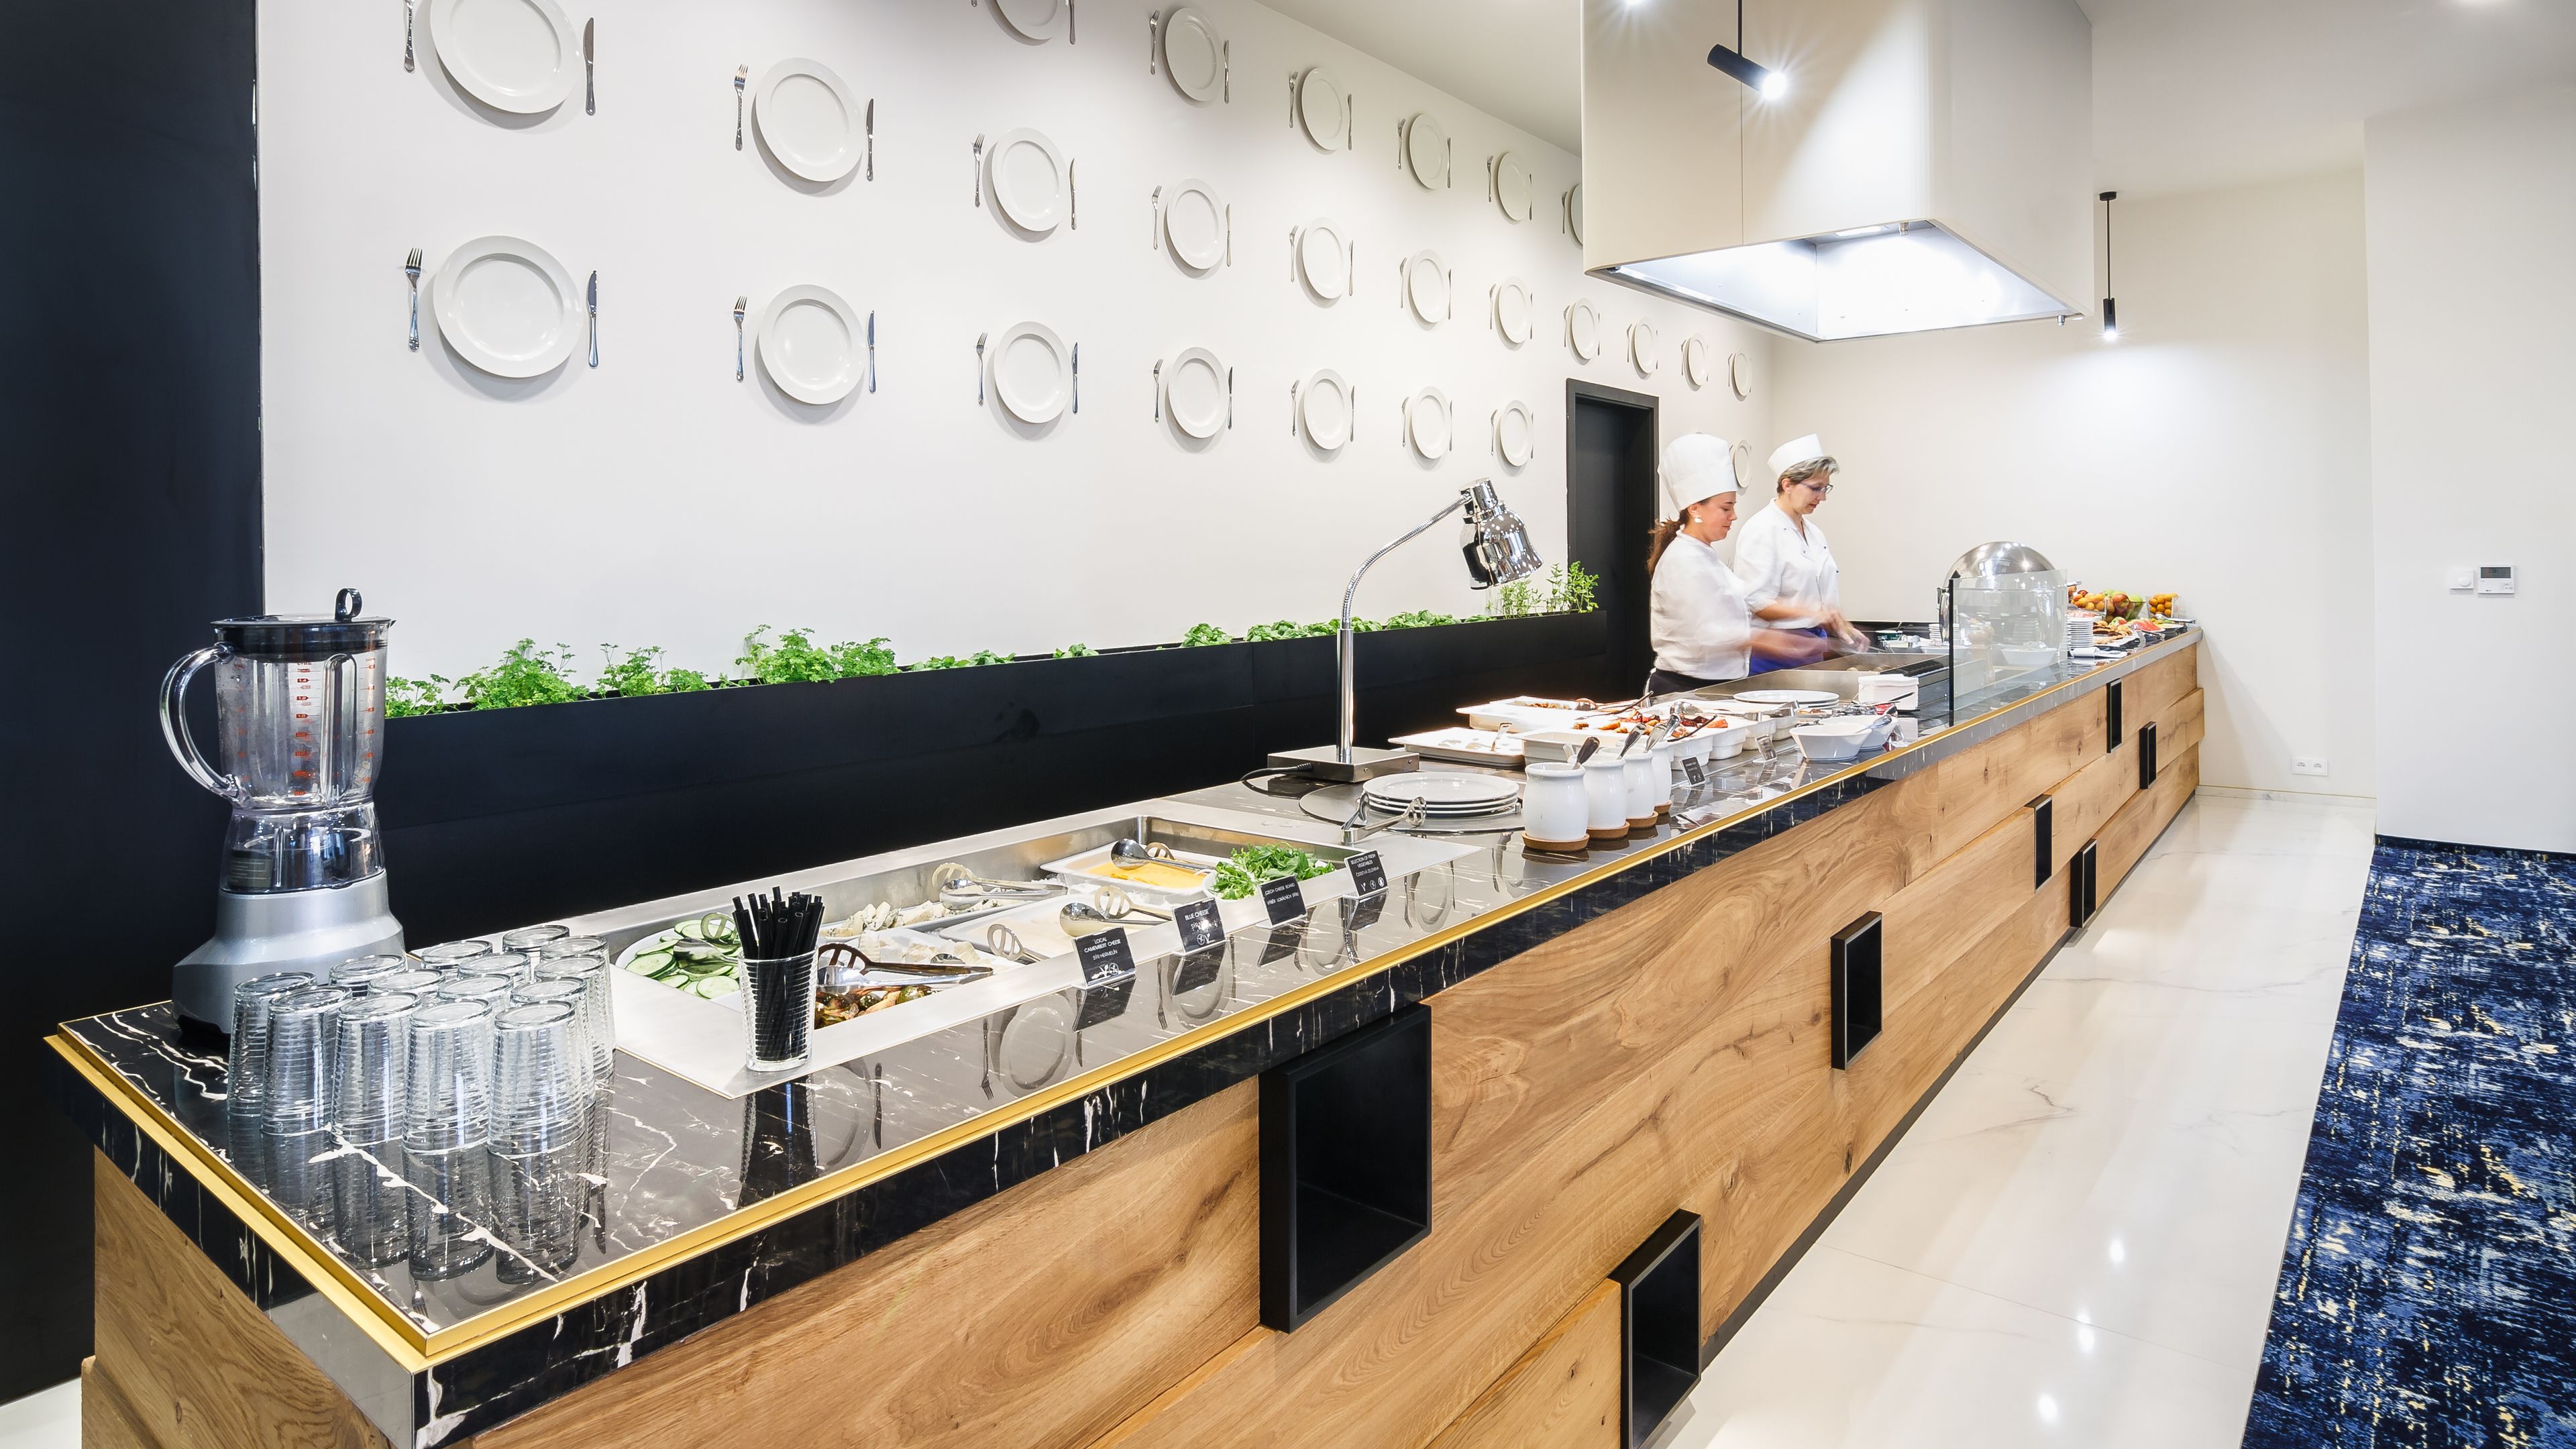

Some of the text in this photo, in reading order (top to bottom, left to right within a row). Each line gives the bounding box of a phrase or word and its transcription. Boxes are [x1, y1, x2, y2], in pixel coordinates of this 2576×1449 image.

[1195, 909, 1209, 917] CHEESE
[1084, 938, 1121, 953] CAMEMBERT CHEESE
